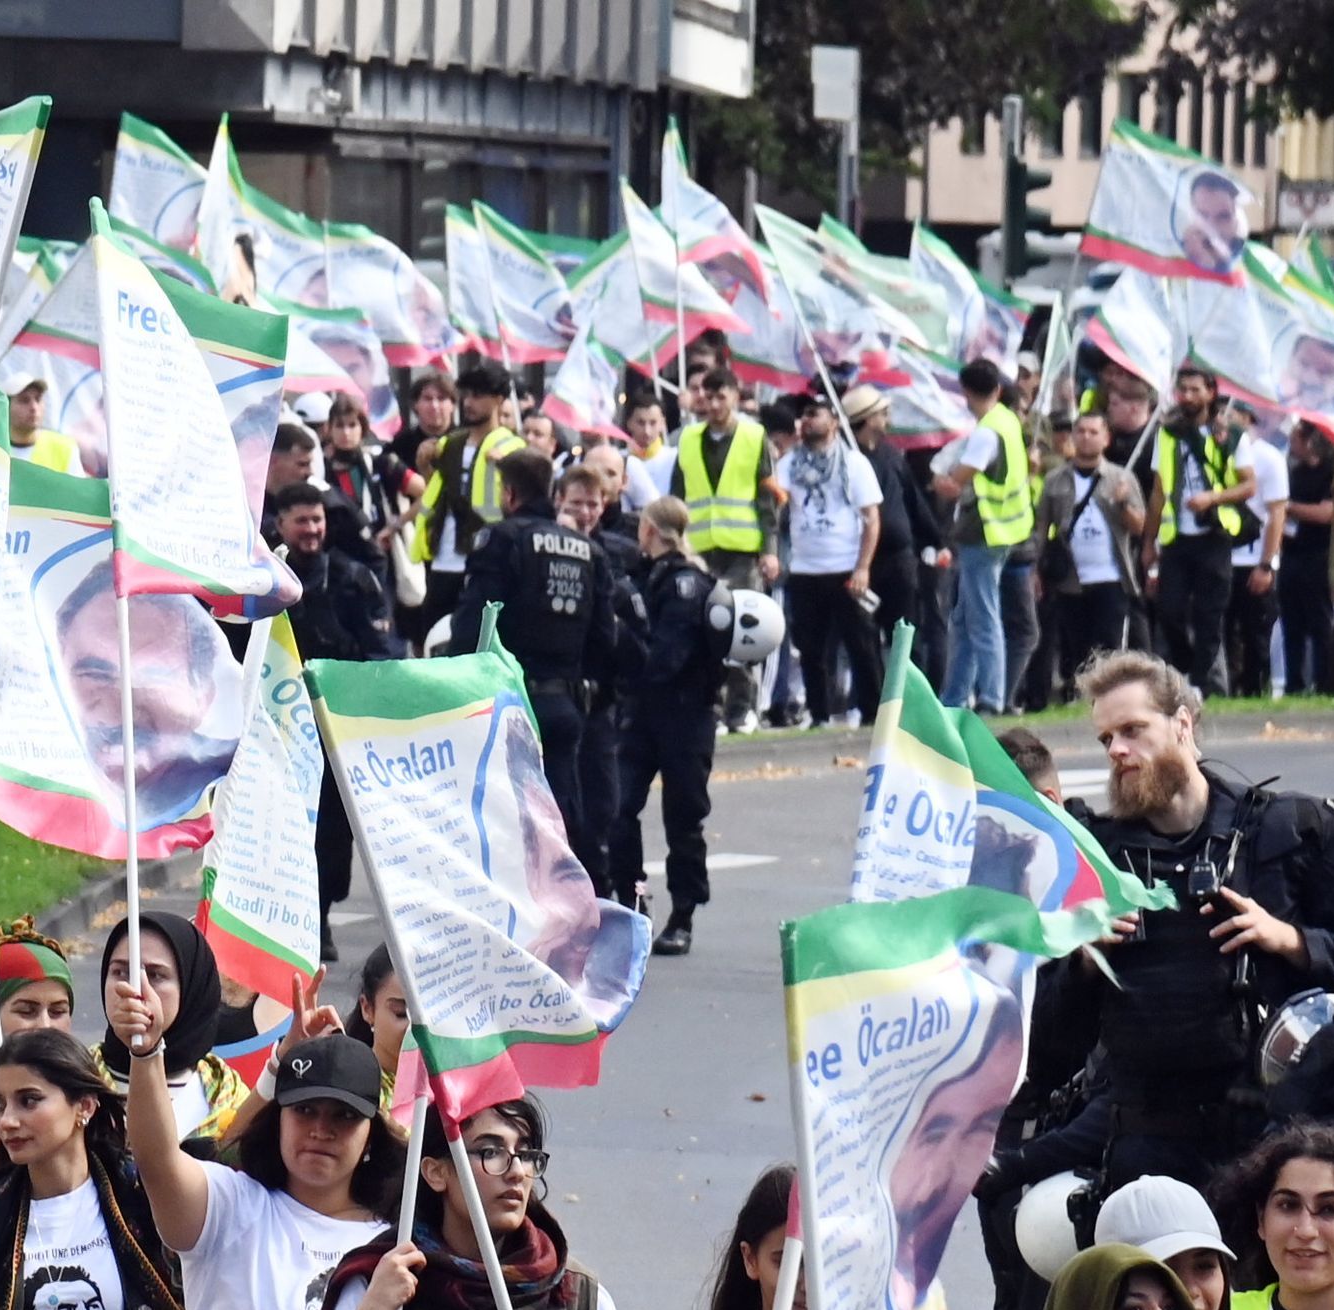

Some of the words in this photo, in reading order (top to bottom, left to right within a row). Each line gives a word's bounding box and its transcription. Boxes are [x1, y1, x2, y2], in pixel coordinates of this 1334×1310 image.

[117, 289, 172, 335] Free
[532, 532, 591, 562] POLIZEI
[546, 580, 583, 598] 21042
[548, 561, 581, 580] NRW
[364, 739, 455, 788] Öcalan
[225, 889, 264, 917] Azadi
[267, 901, 279, 924] ji
[281, 905, 300, 927] bo
[465, 997, 490, 1036] Azadi
[488, 994, 497, 1022] ji
[499, 994, 522, 1011] bo
[805, 1043, 843, 1088] ee
[858, 996, 951, 1068] Öcalan
